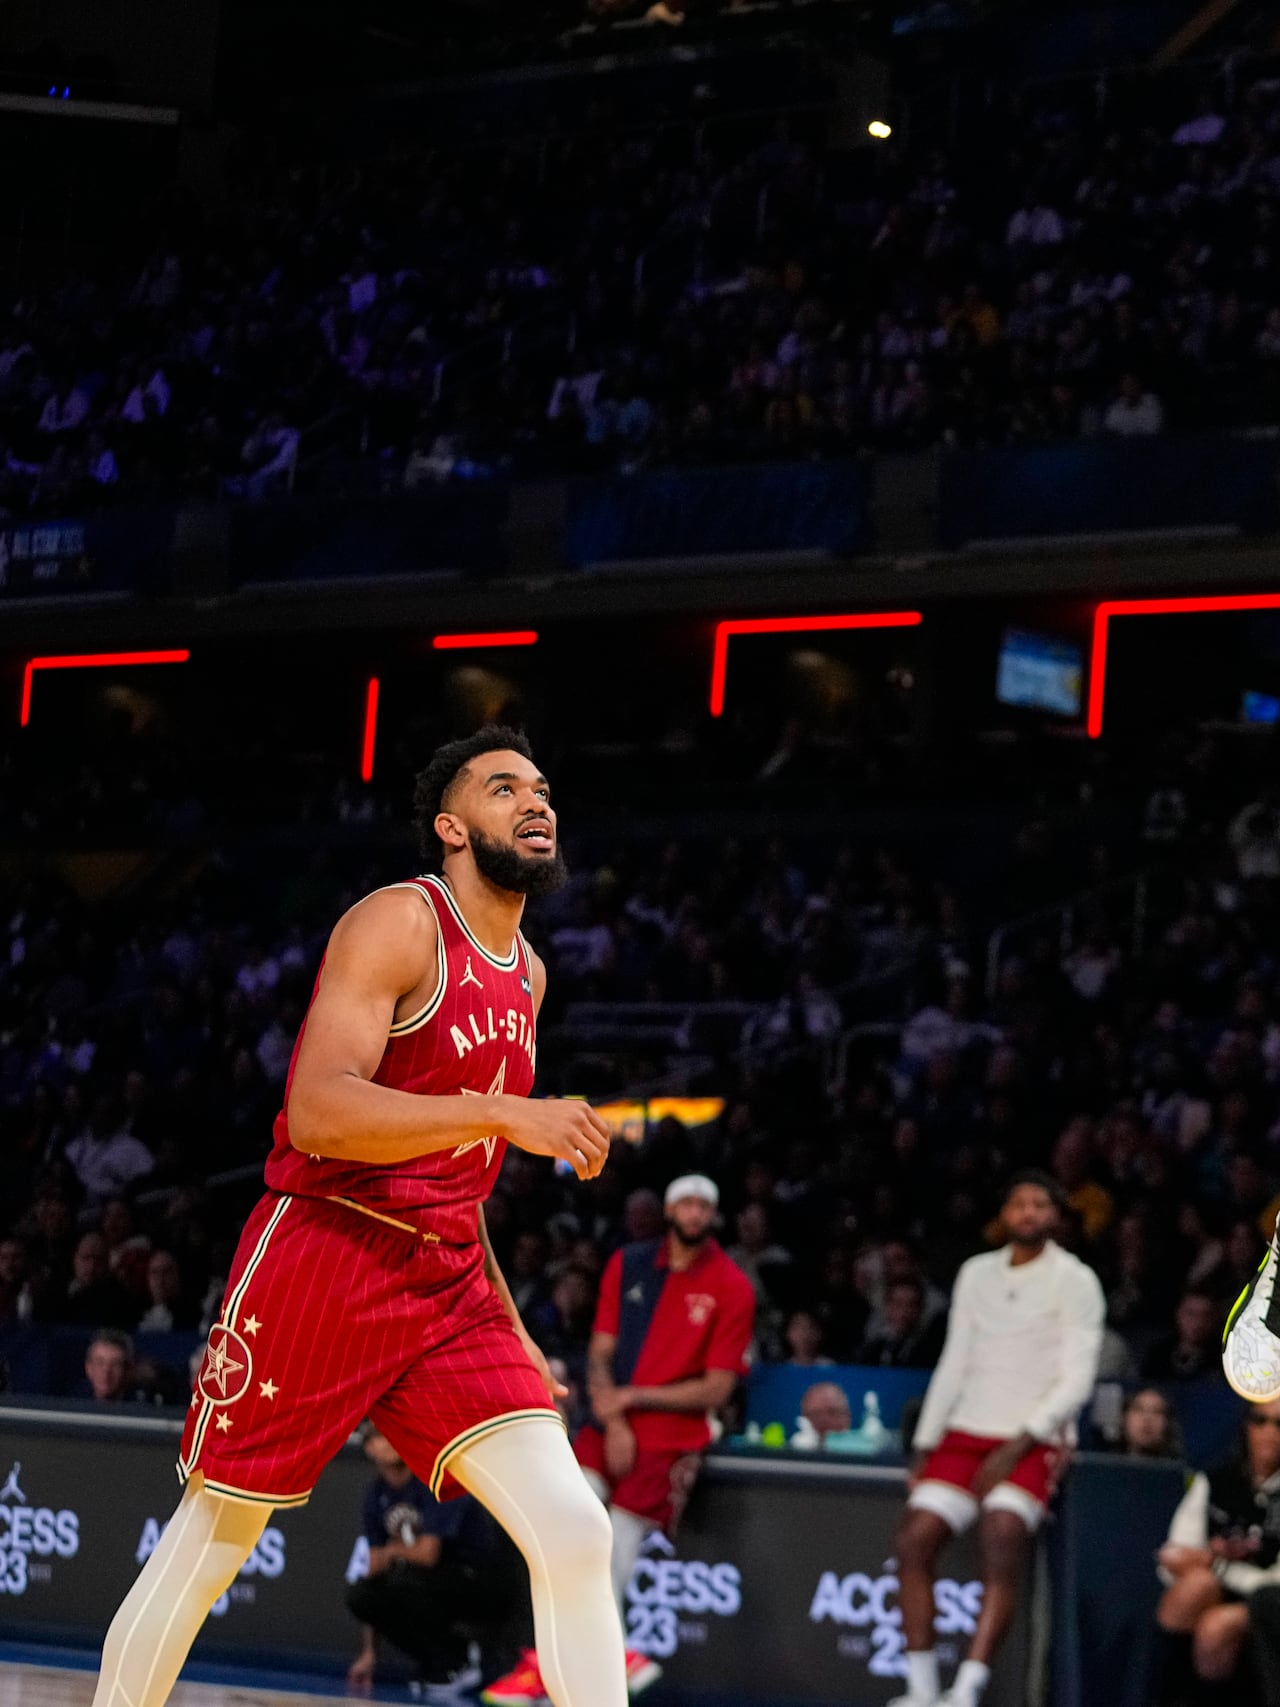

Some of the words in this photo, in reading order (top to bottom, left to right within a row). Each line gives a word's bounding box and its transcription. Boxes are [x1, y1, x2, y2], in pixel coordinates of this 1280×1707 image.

[625, 1557, 741, 1616] CESS
[809, 1570, 984, 1636] ACCSS
[868, 1624, 911, 1678] 2
